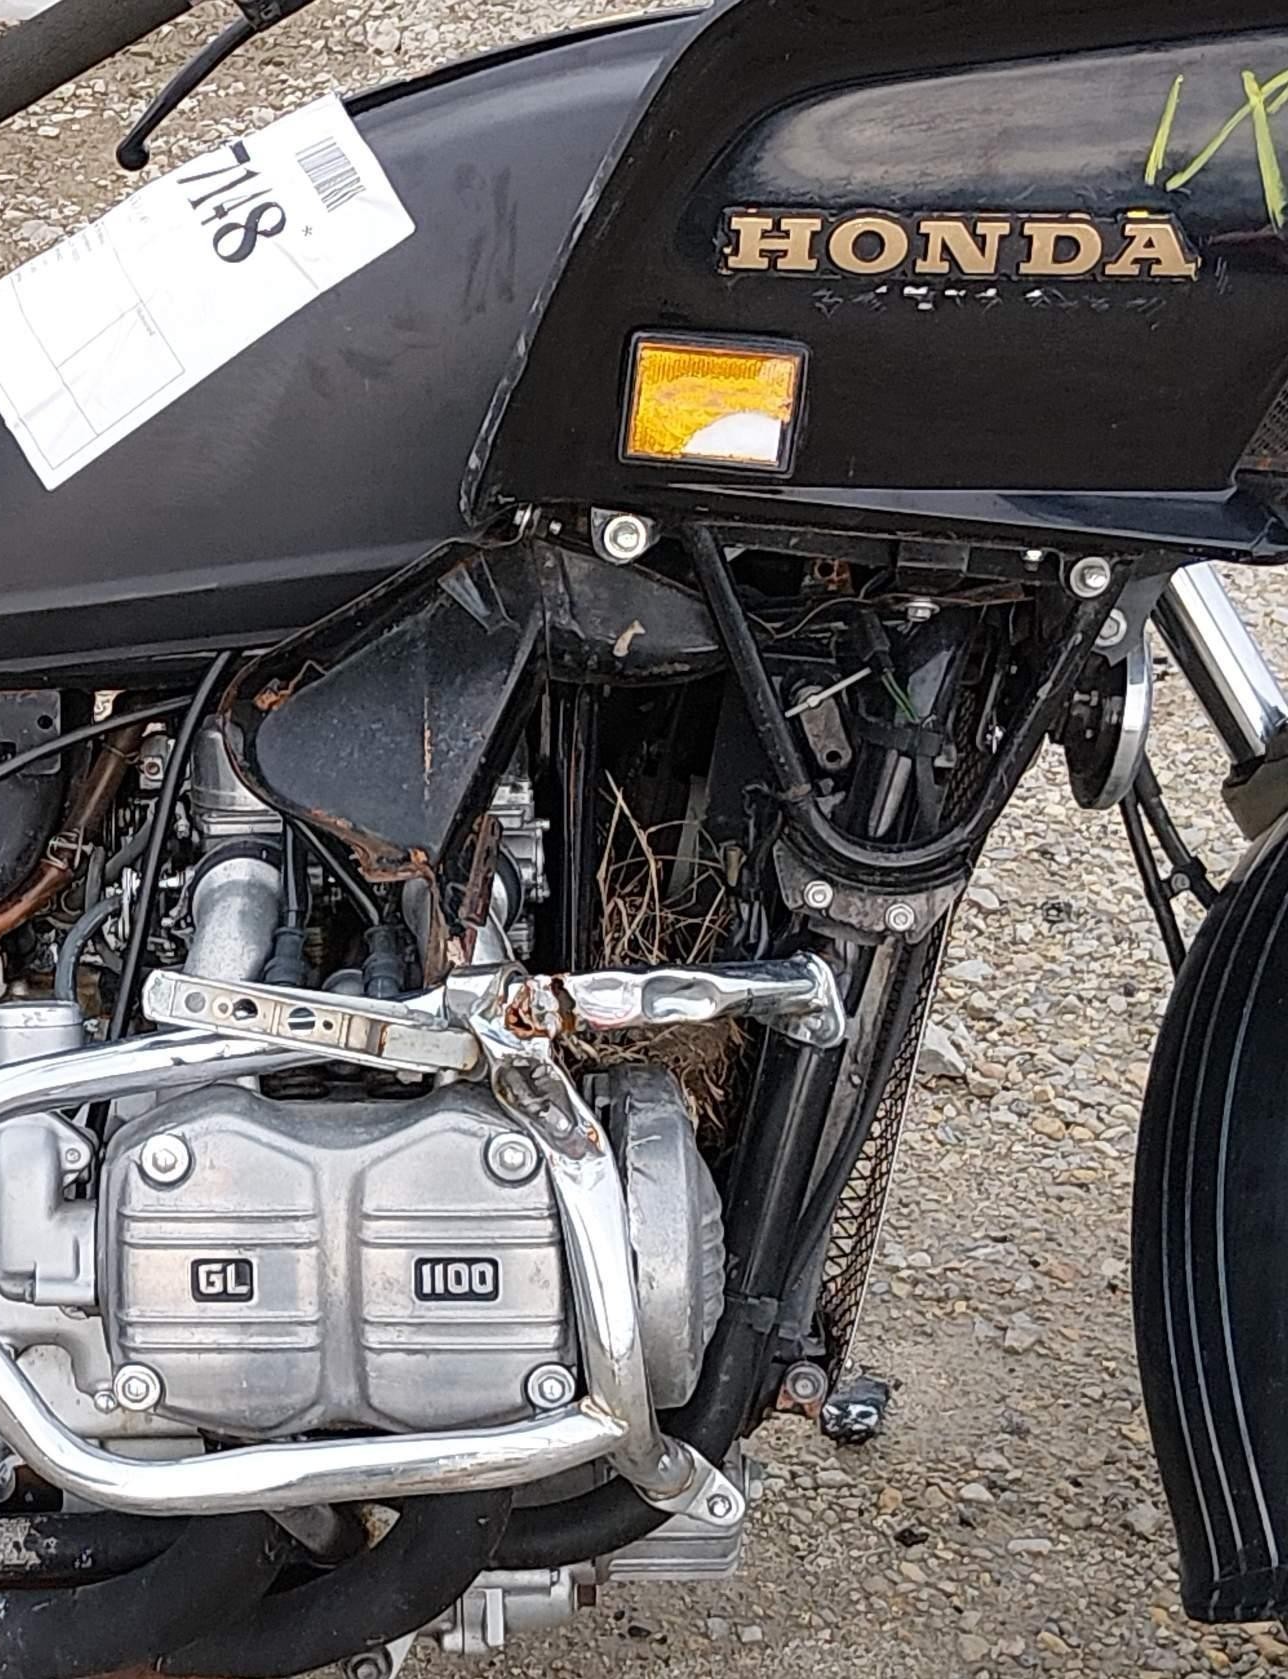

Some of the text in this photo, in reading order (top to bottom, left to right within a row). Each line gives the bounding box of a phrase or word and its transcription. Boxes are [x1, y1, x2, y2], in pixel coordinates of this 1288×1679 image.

[726, 216, 1199, 277] HONDA
[198, 1263, 252, 1294] GL
[421, 1262, 494, 1294] 1100
